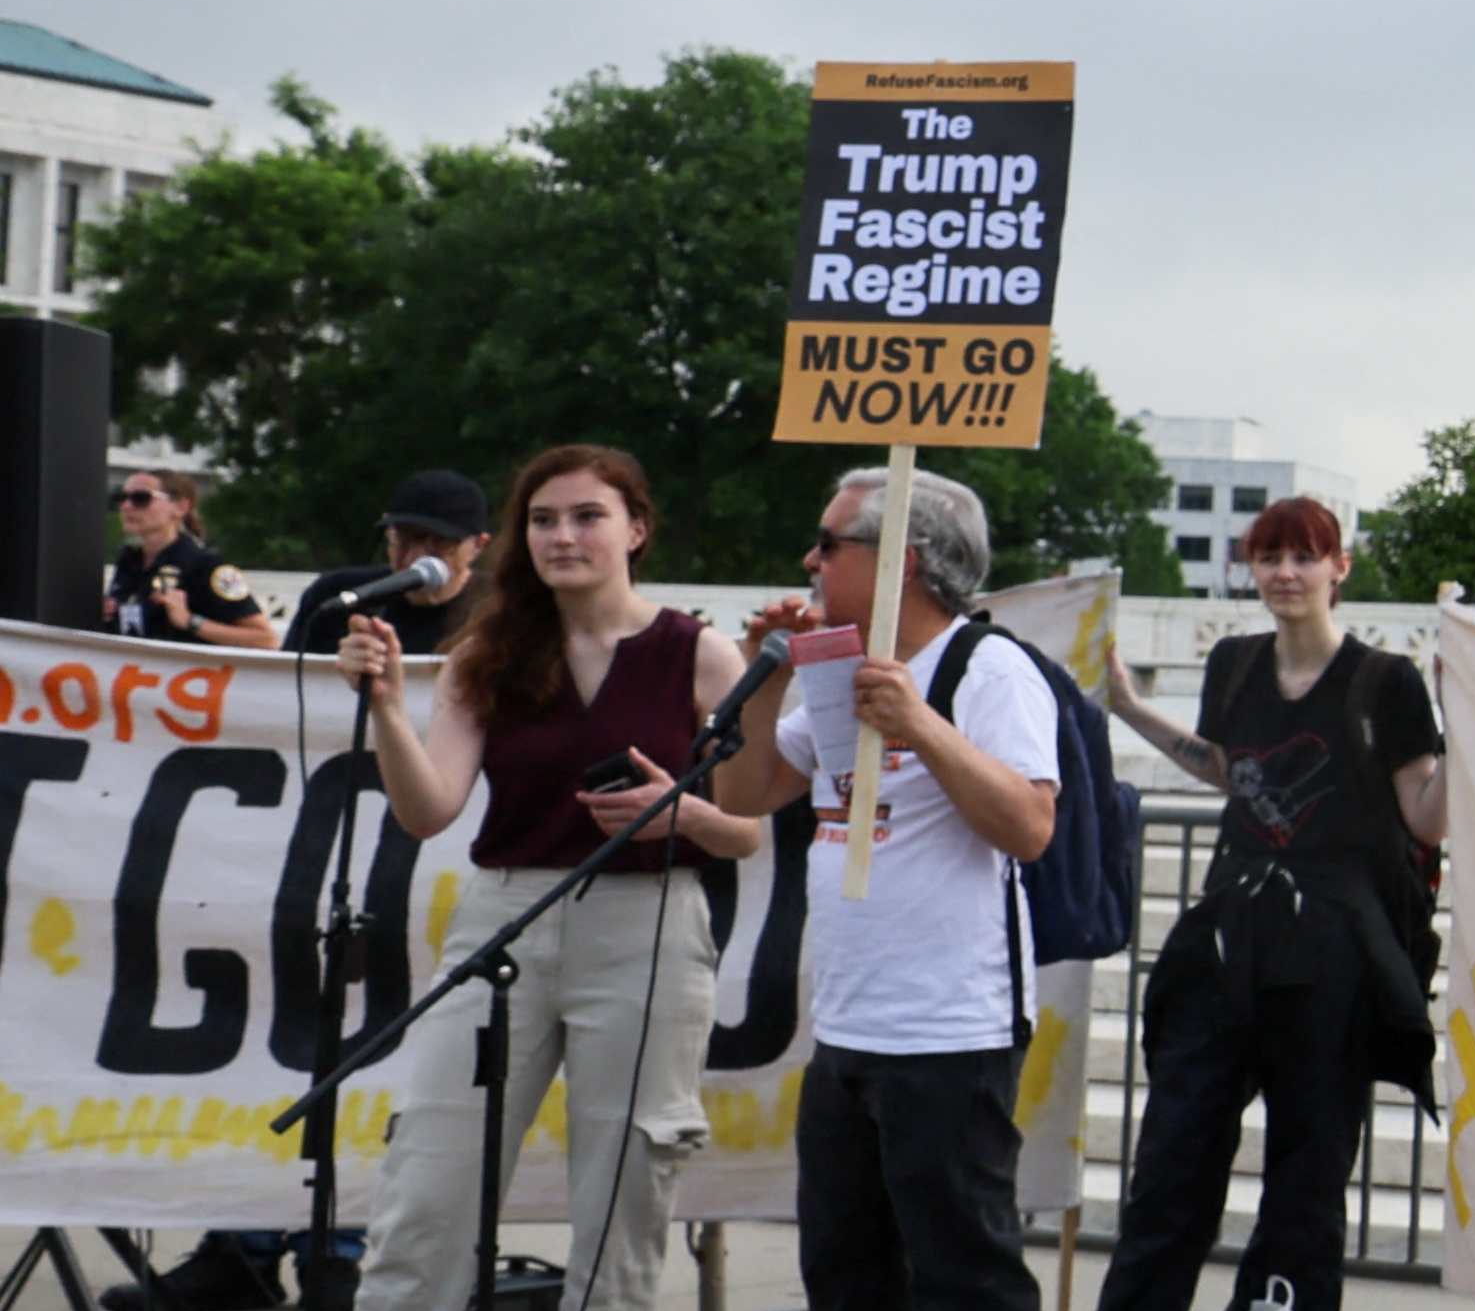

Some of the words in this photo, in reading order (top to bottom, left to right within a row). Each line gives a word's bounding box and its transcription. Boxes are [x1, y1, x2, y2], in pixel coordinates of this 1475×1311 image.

[865, 73, 1030, 91] RefuseFascism.org
[901, 108, 973, 140] The
[837, 144, 1038, 207] Trump
[817, 198, 1046, 250] Fascist
[807, 253, 1042, 317] Regime
[800, 335, 947, 374] MUST
[963, 338, 1036, 376] GO
[812, 379, 1017, 428] NOW!!!
[0, 663, 234, 742] .org
